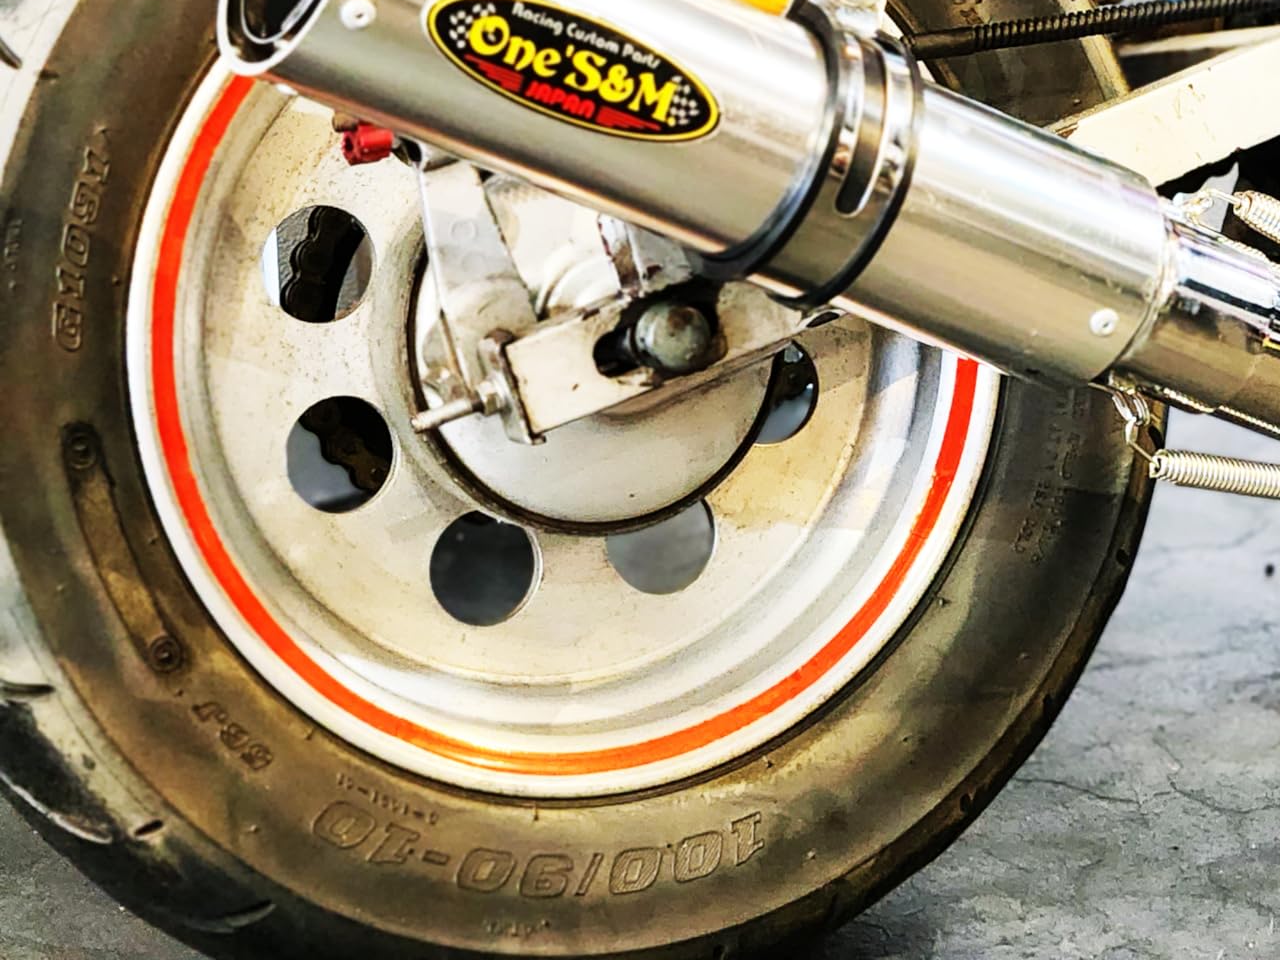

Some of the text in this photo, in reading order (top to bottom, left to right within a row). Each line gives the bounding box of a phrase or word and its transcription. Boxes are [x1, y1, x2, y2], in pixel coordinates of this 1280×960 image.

[511, 0, 661, 69] Racing Custom Parts
[524, 81, 596, 119] JAPAN
[311, 810, 766, 899] 100/90-10
